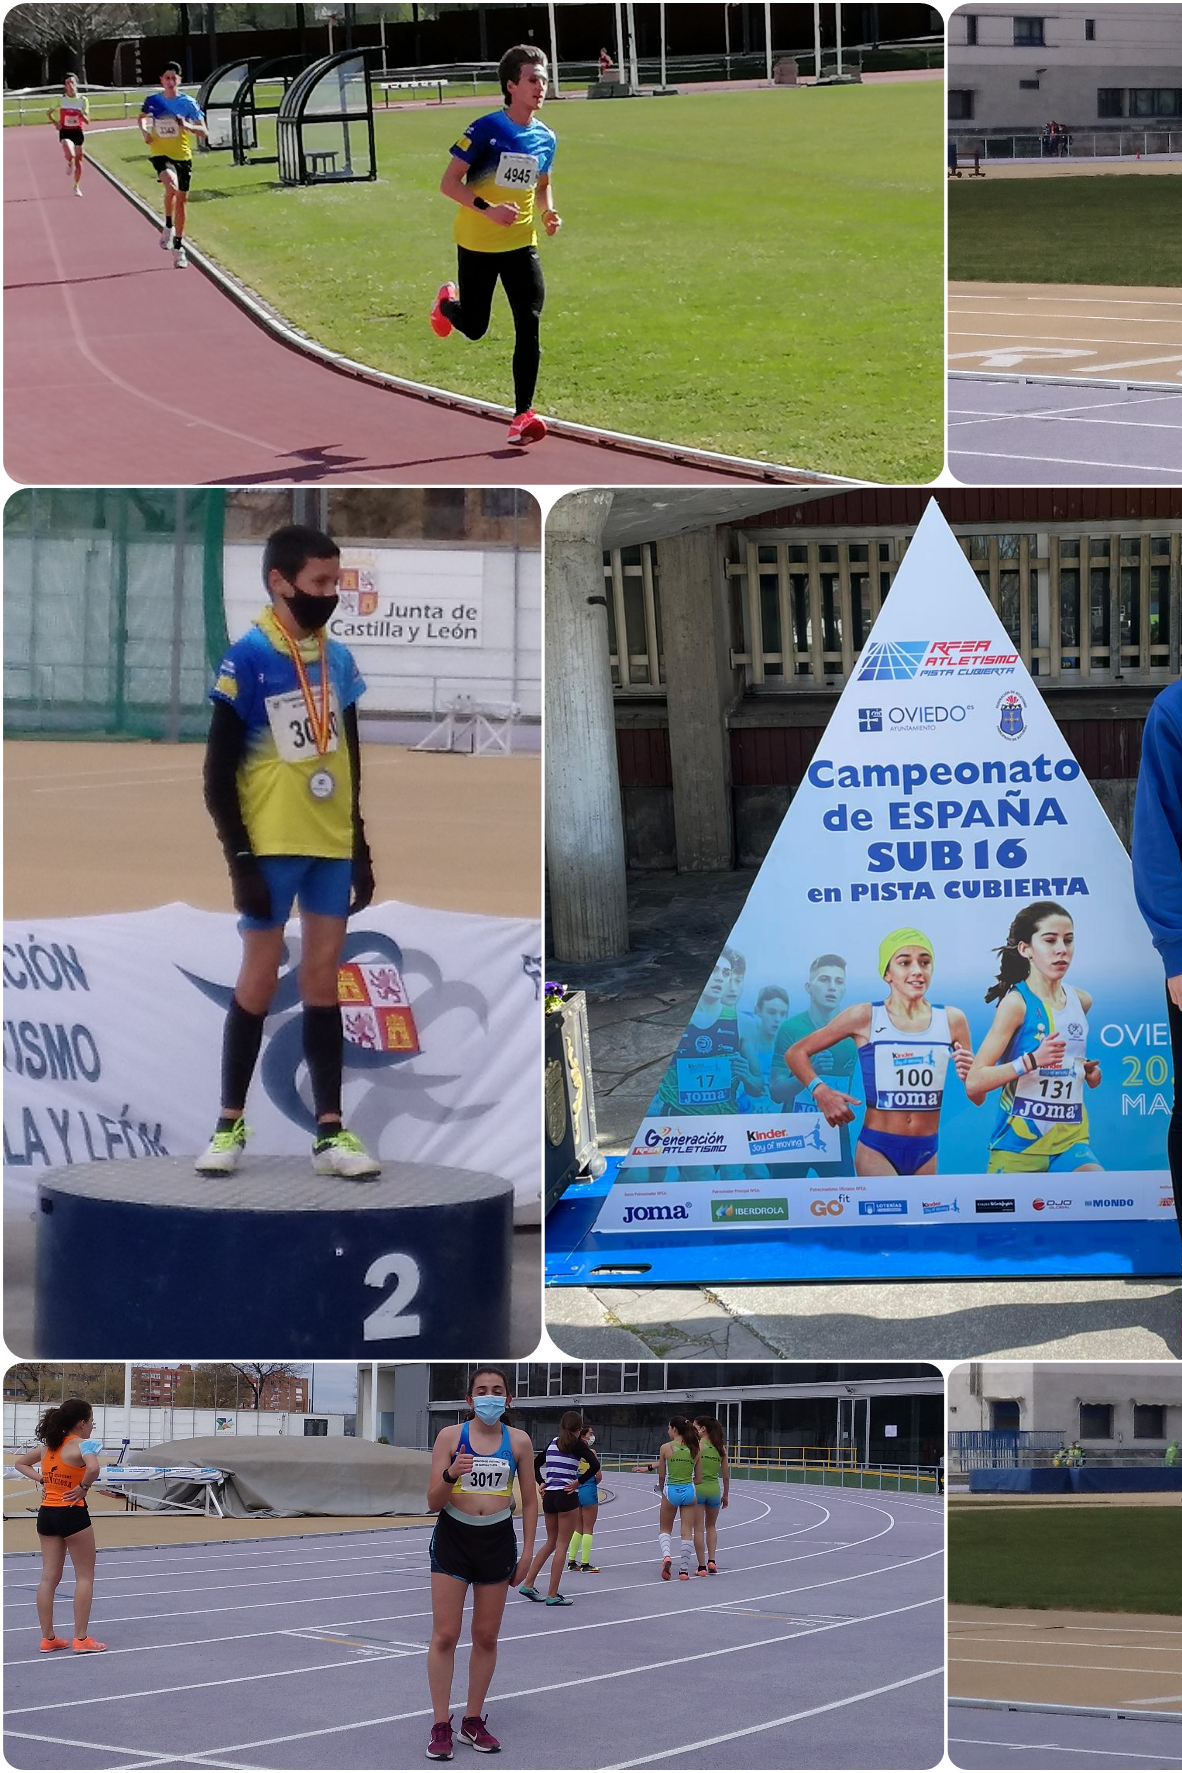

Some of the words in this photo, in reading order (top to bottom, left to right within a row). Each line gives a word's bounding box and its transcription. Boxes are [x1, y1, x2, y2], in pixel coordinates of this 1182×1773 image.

[504, 167, 531, 183] 4945
[384, 602, 443, 619] Junta
[452, 604, 478, 620] de
[330, 619, 402, 637] Castilla
[408, 626, 420, 643] y
[427, 623, 478, 640] León
[929, 640, 992, 656] RFEA
[924, 654, 1019, 667] ATLETISMO
[919, 669, 955, 677] PISTA
[957, 667, 1016, 677] CUBIERTA
[888, 705, 967, 724] OVIEDO
[890, 724, 937, 732] AYUNTAMIENTO
[807, 753, 1081, 795] Campeonato
[822, 803, 873, 831] de
[889, 789, 1069, 830] ESPAÑA
[807, 886, 842, 903] en
[851, 881, 936, 902] PISTA
[943, 876, 1090, 900] CUBIERTA
[3, 933, 90, 991] CIÓN
[1100, 1023, 1172, 1047] OVIE
[696, 1074, 715, 1088] 17
[896, 1068, 933, 1087] 100
[1039, 1078, 1073, 1100] 131
[46, 1107, 73, 1165] Y
[644, 1128, 725, 1148] Generación
[767, 1141, 775, 1150] of
[775, 1138, 803, 1150] moving
[662, 1145, 727, 1154] ATLETISMO
[735, 1206, 785, 1215] IBERDROLA
[810, 1199, 844, 1217] GO
[838, 1193, 851, 1203] fit
[1092, 1198, 1134, 1208] MONDO
[363, 1252, 421, 1342] 2
[470, 1471, 503, 1488] 3017
